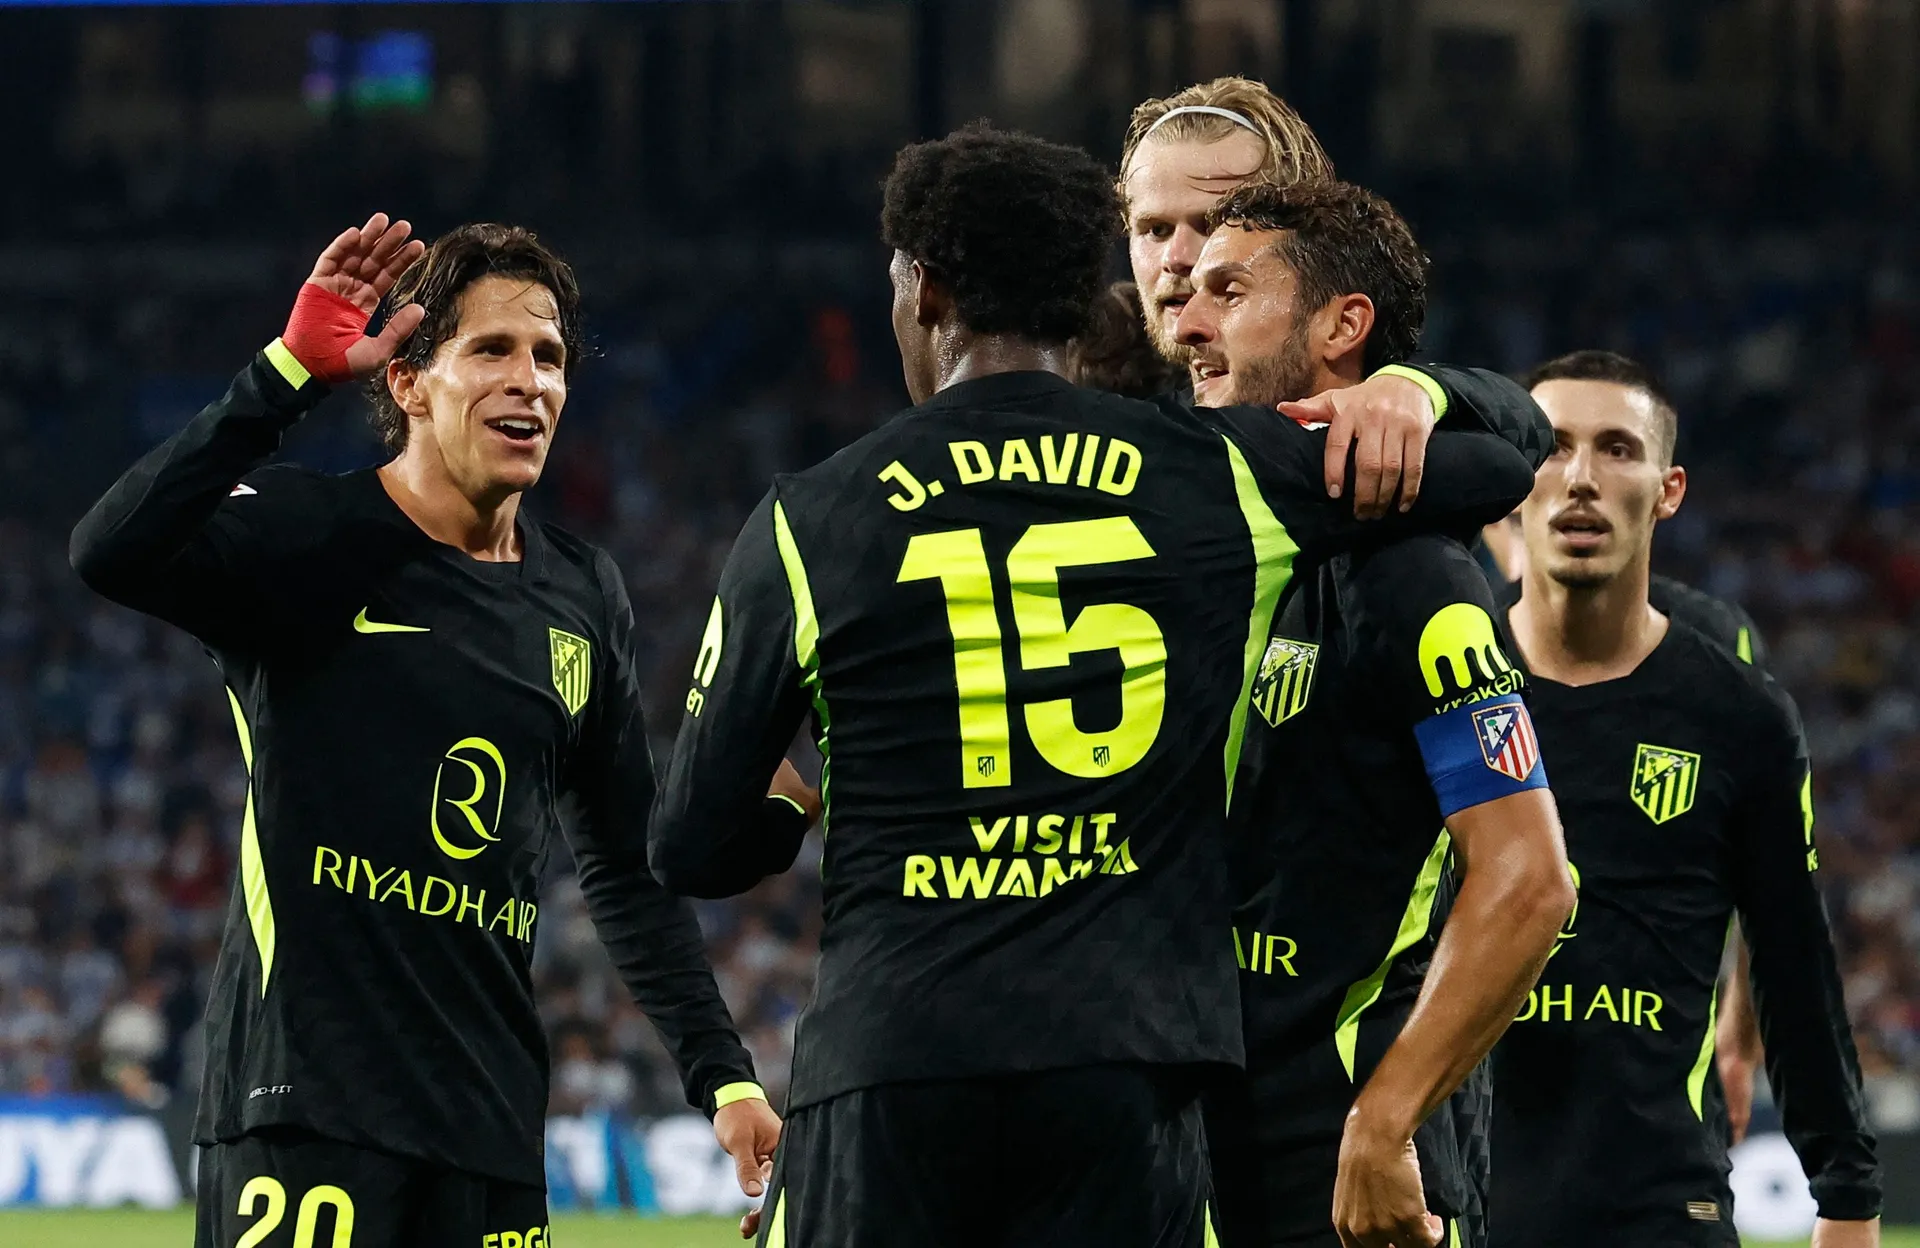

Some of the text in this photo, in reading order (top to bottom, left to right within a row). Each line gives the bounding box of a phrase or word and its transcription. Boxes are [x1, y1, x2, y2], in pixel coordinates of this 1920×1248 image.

[877, 432, 1143, 512] J. DAVID
[895, 515, 1168, 789] 15
[968, 812, 1117, 855] VISIT
[312, 845, 537, 944] RIYADH AIR
[1583, 984, 1663, 1031] AIR
[234, 1175, 355, 1248] 20
